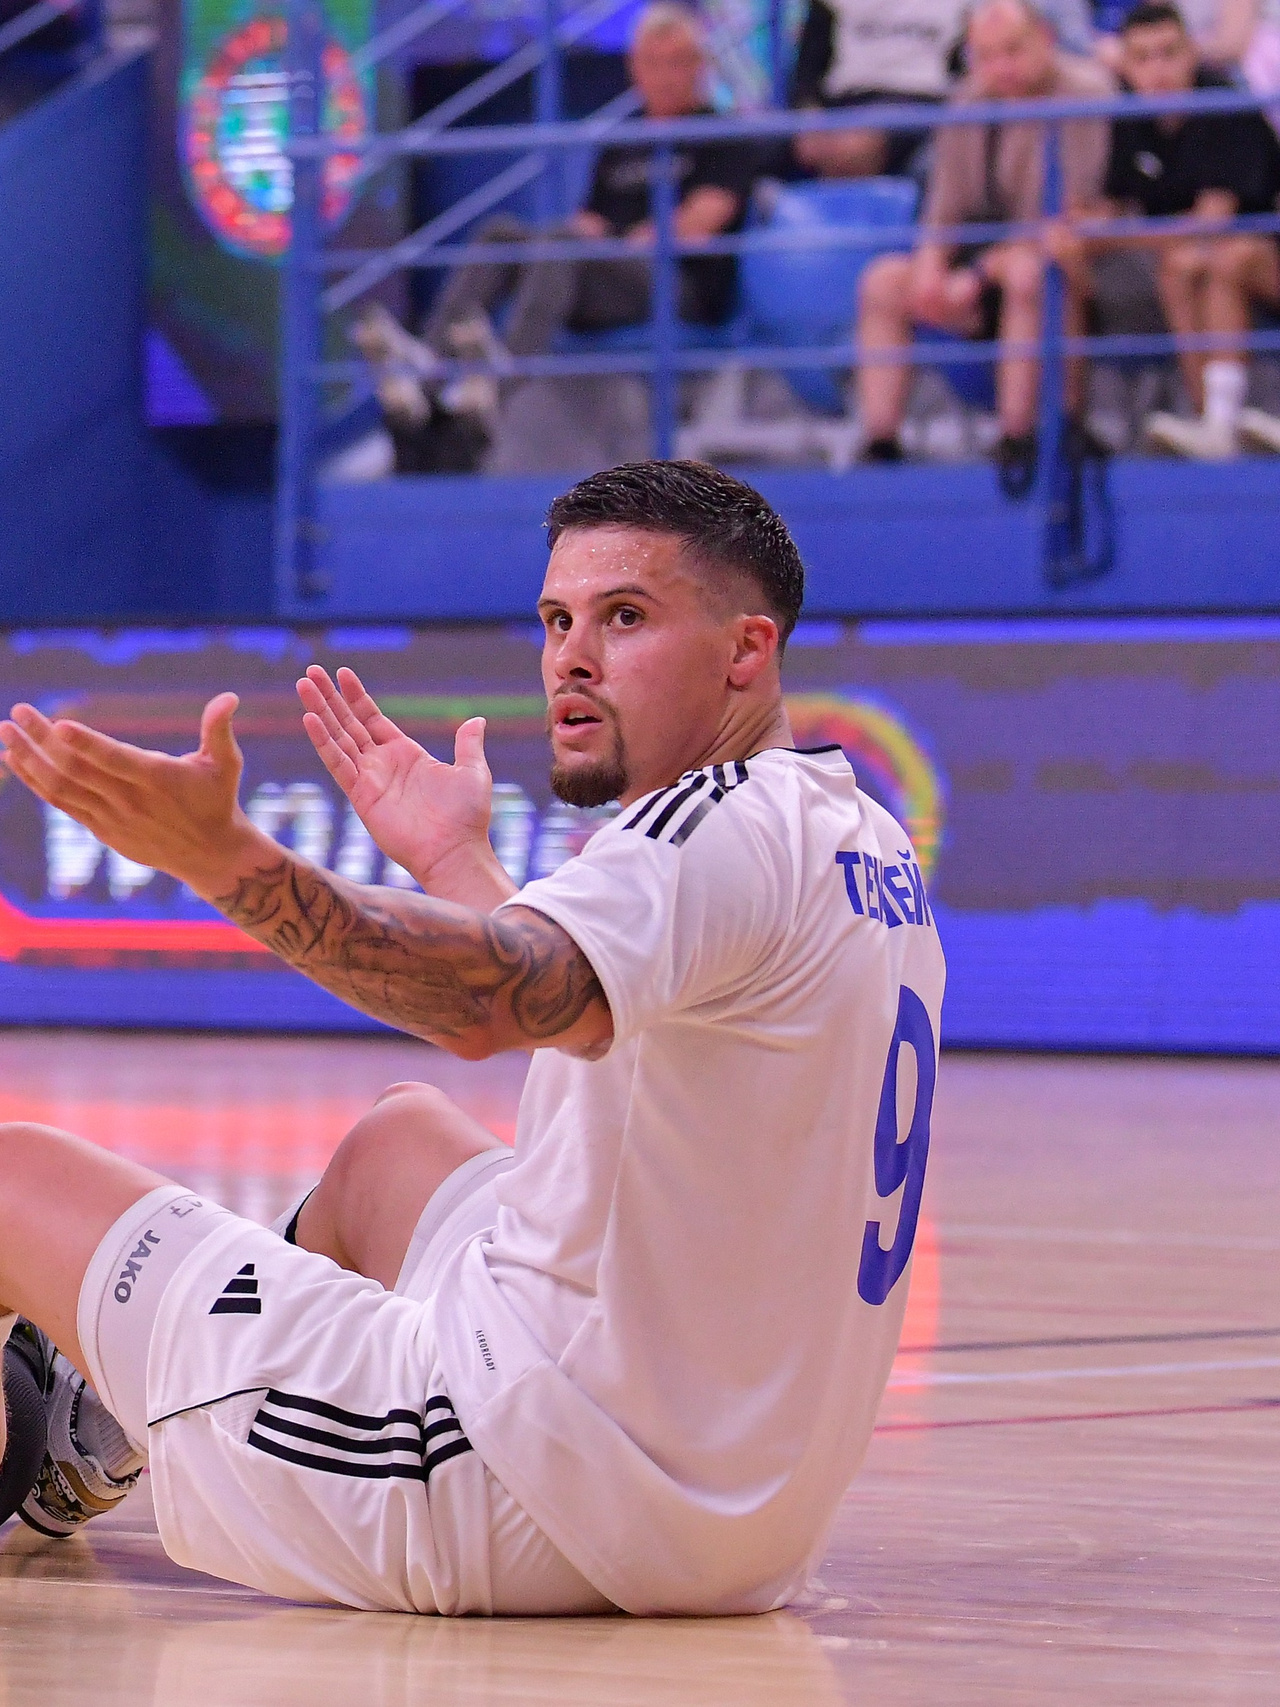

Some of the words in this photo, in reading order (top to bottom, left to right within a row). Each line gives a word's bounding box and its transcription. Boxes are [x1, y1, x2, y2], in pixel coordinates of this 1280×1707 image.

[857, 984, 936, 1306] 9
[114, 1229, 161, 1304] JAKO
[475, 1329, 496, 1371] AEROREADY
